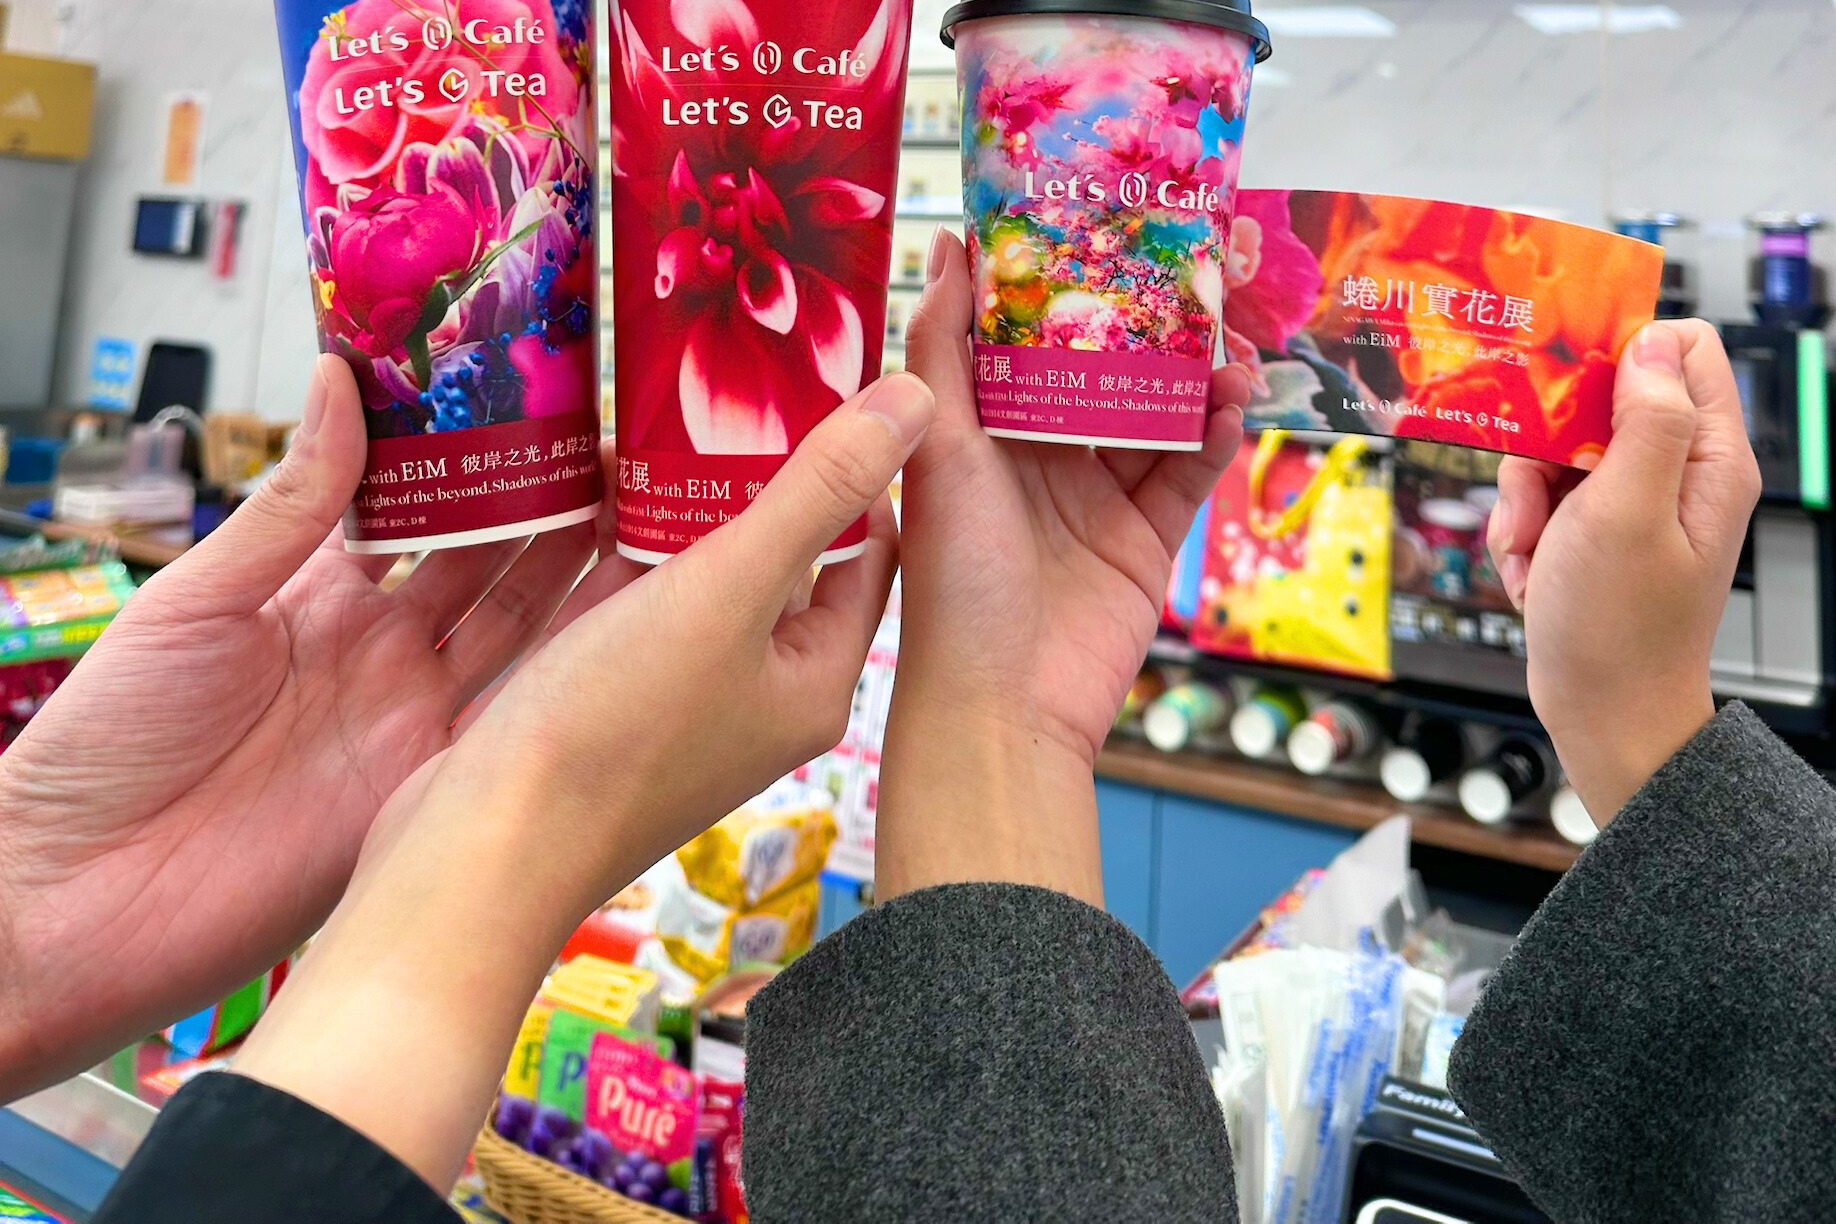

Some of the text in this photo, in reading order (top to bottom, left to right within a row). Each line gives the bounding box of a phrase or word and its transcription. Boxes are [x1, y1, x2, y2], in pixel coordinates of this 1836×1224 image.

[329, 17, 545, 62] Let's Café
[662, 45, 866, 78] Let's Café
[334, 70, 547, 115] Let's Tea
[662, 96, 863, 131] Let's Tea
[1025, 171, 1219, 212] Let's Café
[1342, 274, 1535, 333] 蜷川實花展
[1342, 334, 1367, 347] with
[1369, 332, 1401, 349] EiM
[1015, 373, 1042, 387] with
[1045, 369, 1087, 390] EiM
[1040, 392, 1053, 405] of
[1054, 393, 1073, 407] the
[1342, 397, 1521, 434] Let's Café Let's Tea
[368, 468, 399, 484] with
[400, 457, 449, 482] EiM
[397, 490, 412, 505] of
[413, 489, 435, 504] the
[549, 467, 562, 483] of
[562, 465, 579, 480] this
[616, 456, 652, 494] 花展
[653, 482, 683, 498] with
[686, 478, 732, 500] EiM
[646, 504, 679, 523] Lights
[680, 507, 695, 522] of
[695, 508, 716, 523] the
